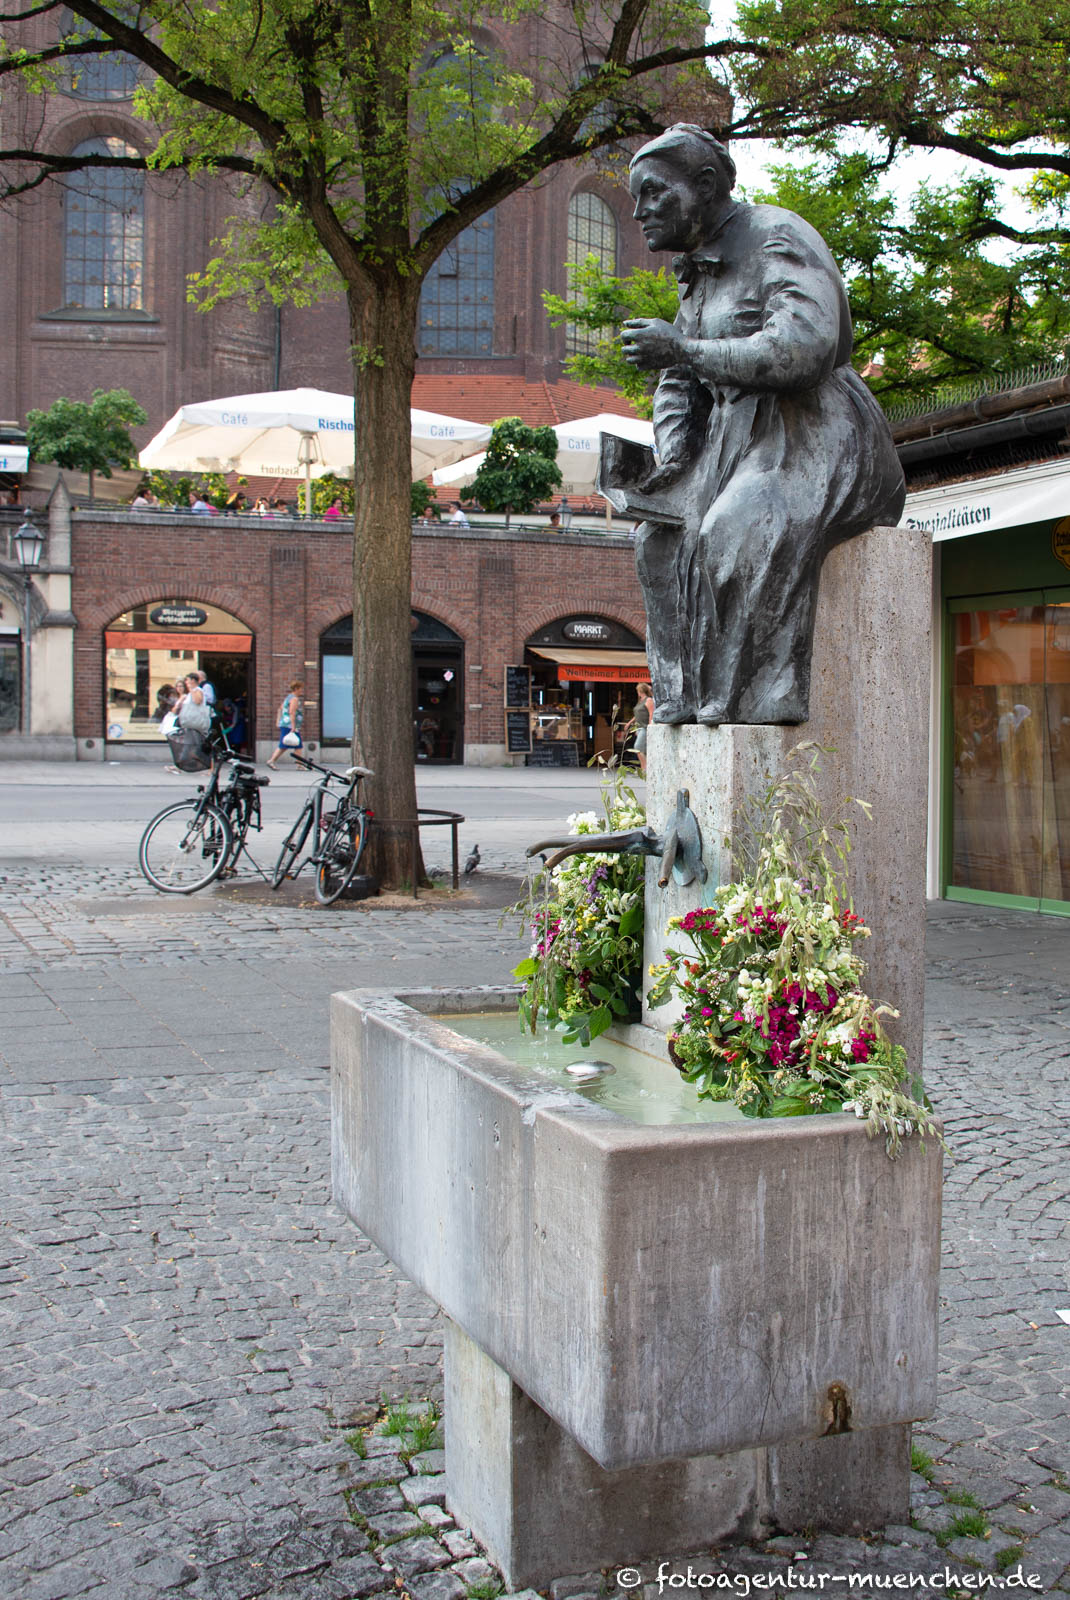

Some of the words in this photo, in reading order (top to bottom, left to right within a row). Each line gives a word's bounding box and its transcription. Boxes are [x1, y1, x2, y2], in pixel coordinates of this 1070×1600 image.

[221, 412, 248, 425] Café
[318, 417, 355, 431] Rischa
[430, 425, 455, 437] Café
[568, 438, 591, 449] Café
[574, 624, 603, 634] MARKT
[565, 668, 615, 678] Weilheimer
